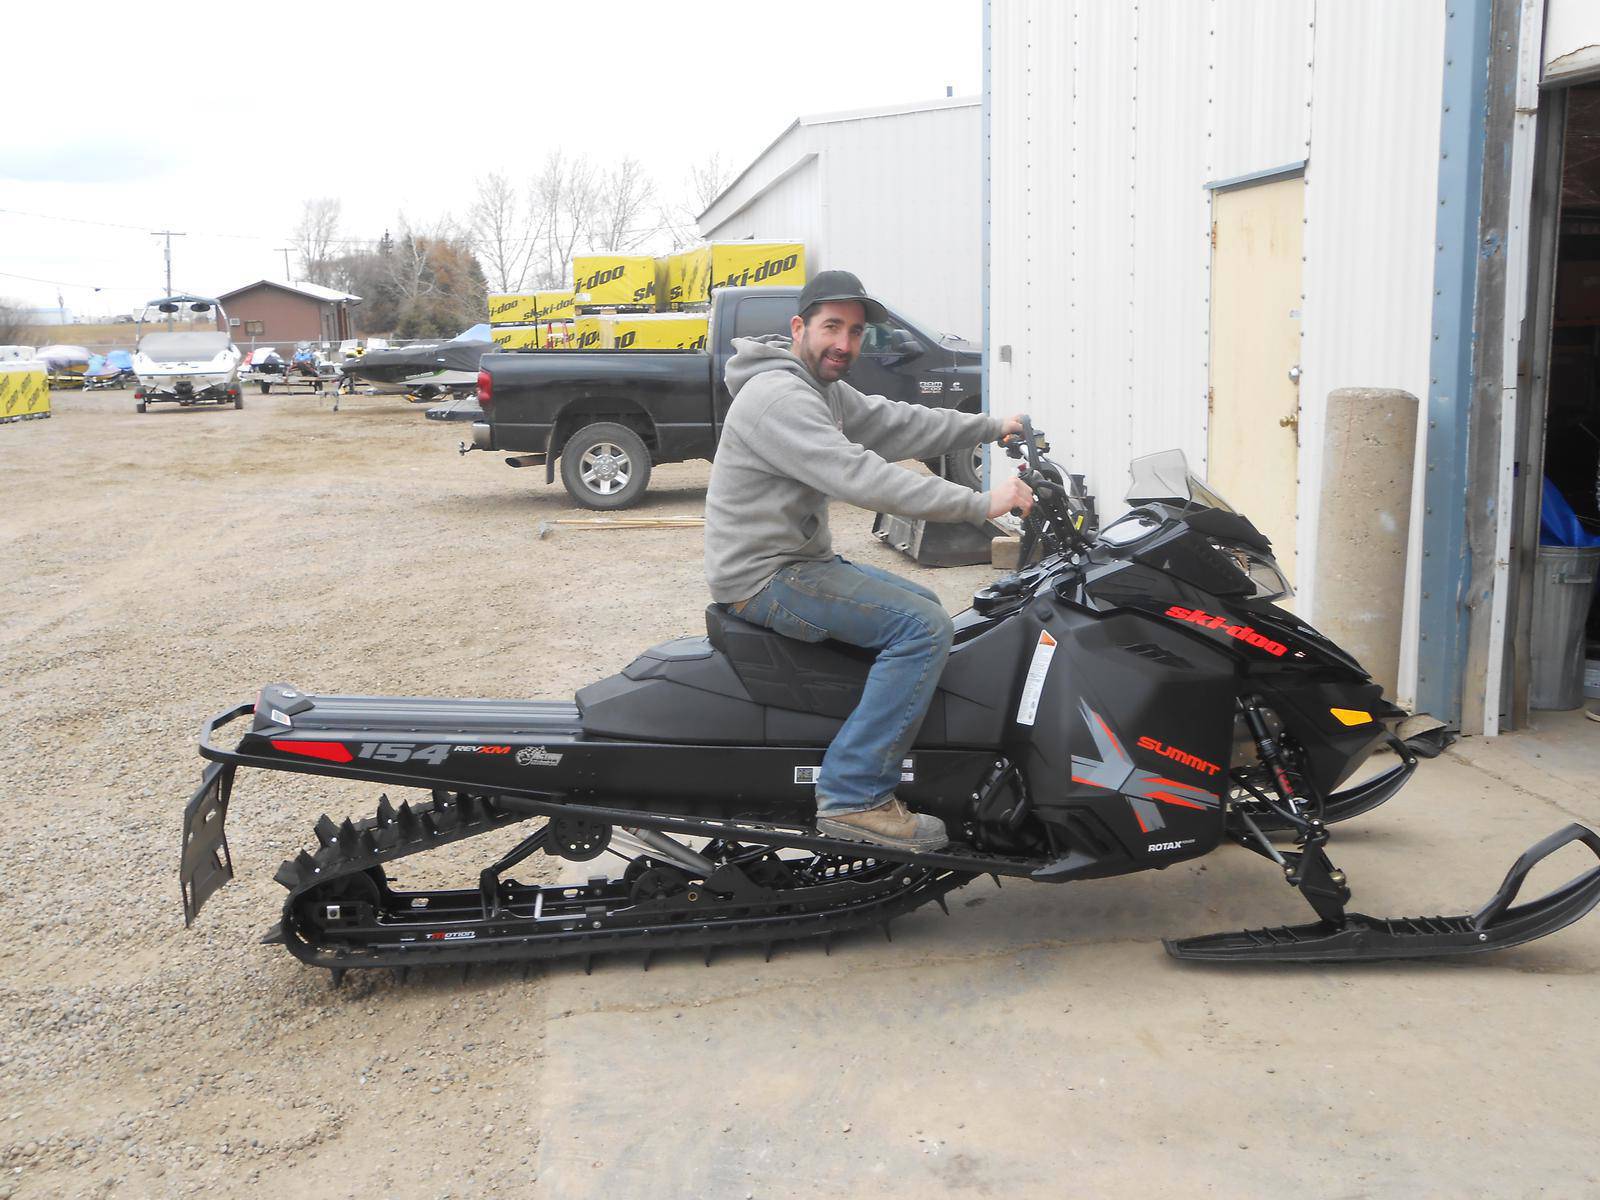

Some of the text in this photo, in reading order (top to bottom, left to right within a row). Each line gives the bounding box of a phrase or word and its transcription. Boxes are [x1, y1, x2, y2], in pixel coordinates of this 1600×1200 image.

[1164, 605, 1288, 656] ski-doo
[358, 742, 452, 764] 154
[1136, 736, 1220, 776] SUMMIT
[1148, 841, 1182, 852] ROTAX
